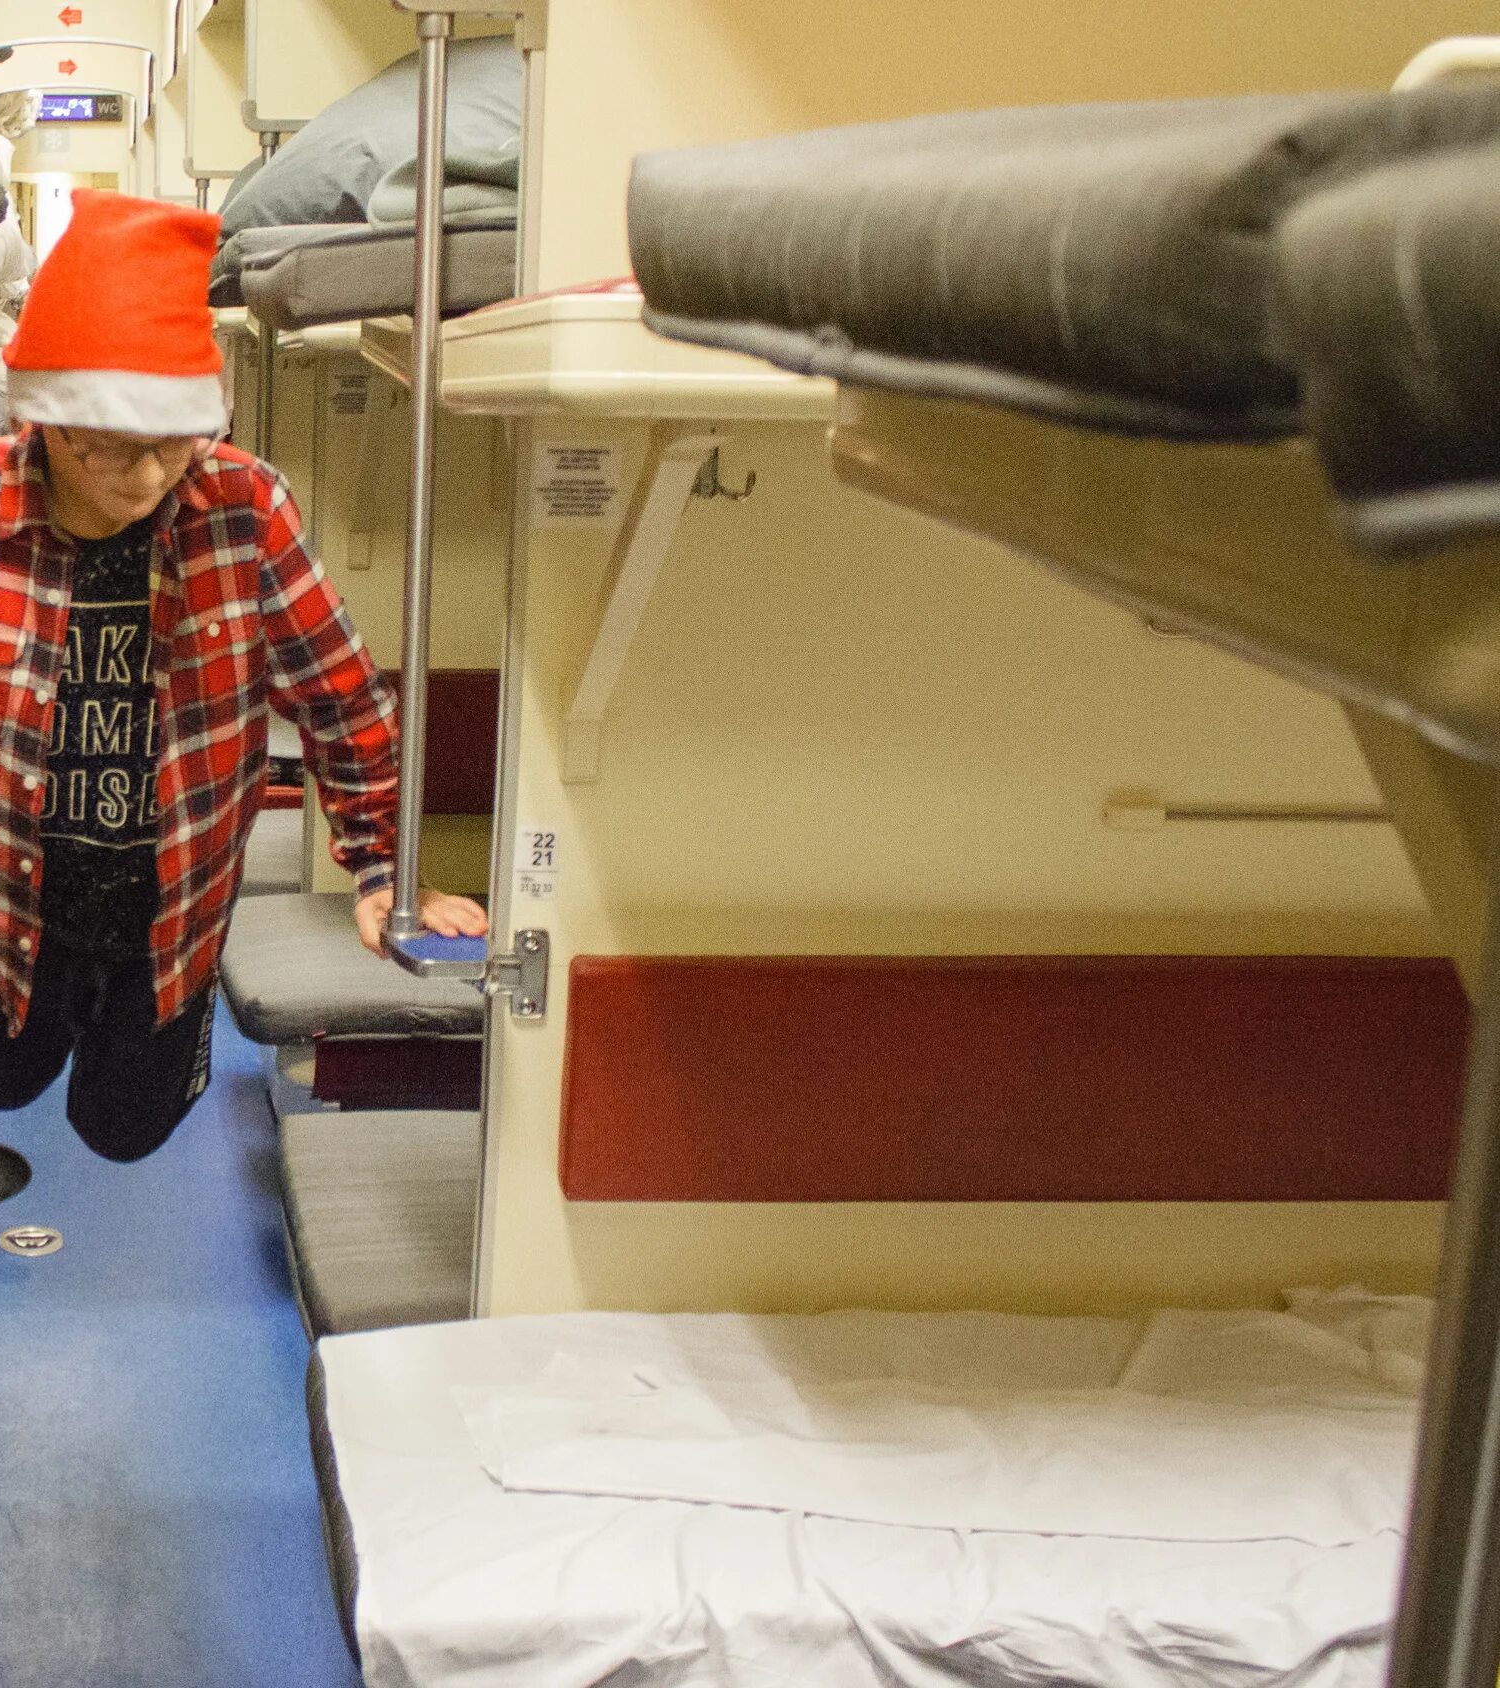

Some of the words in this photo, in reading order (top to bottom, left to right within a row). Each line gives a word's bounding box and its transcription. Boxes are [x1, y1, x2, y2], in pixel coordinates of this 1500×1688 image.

[97, 102, 119, 114] WC
[58, 624, 153, 684] AK
[533, 833, 555, 848] 22
[532, 851, 552, 866] 21
